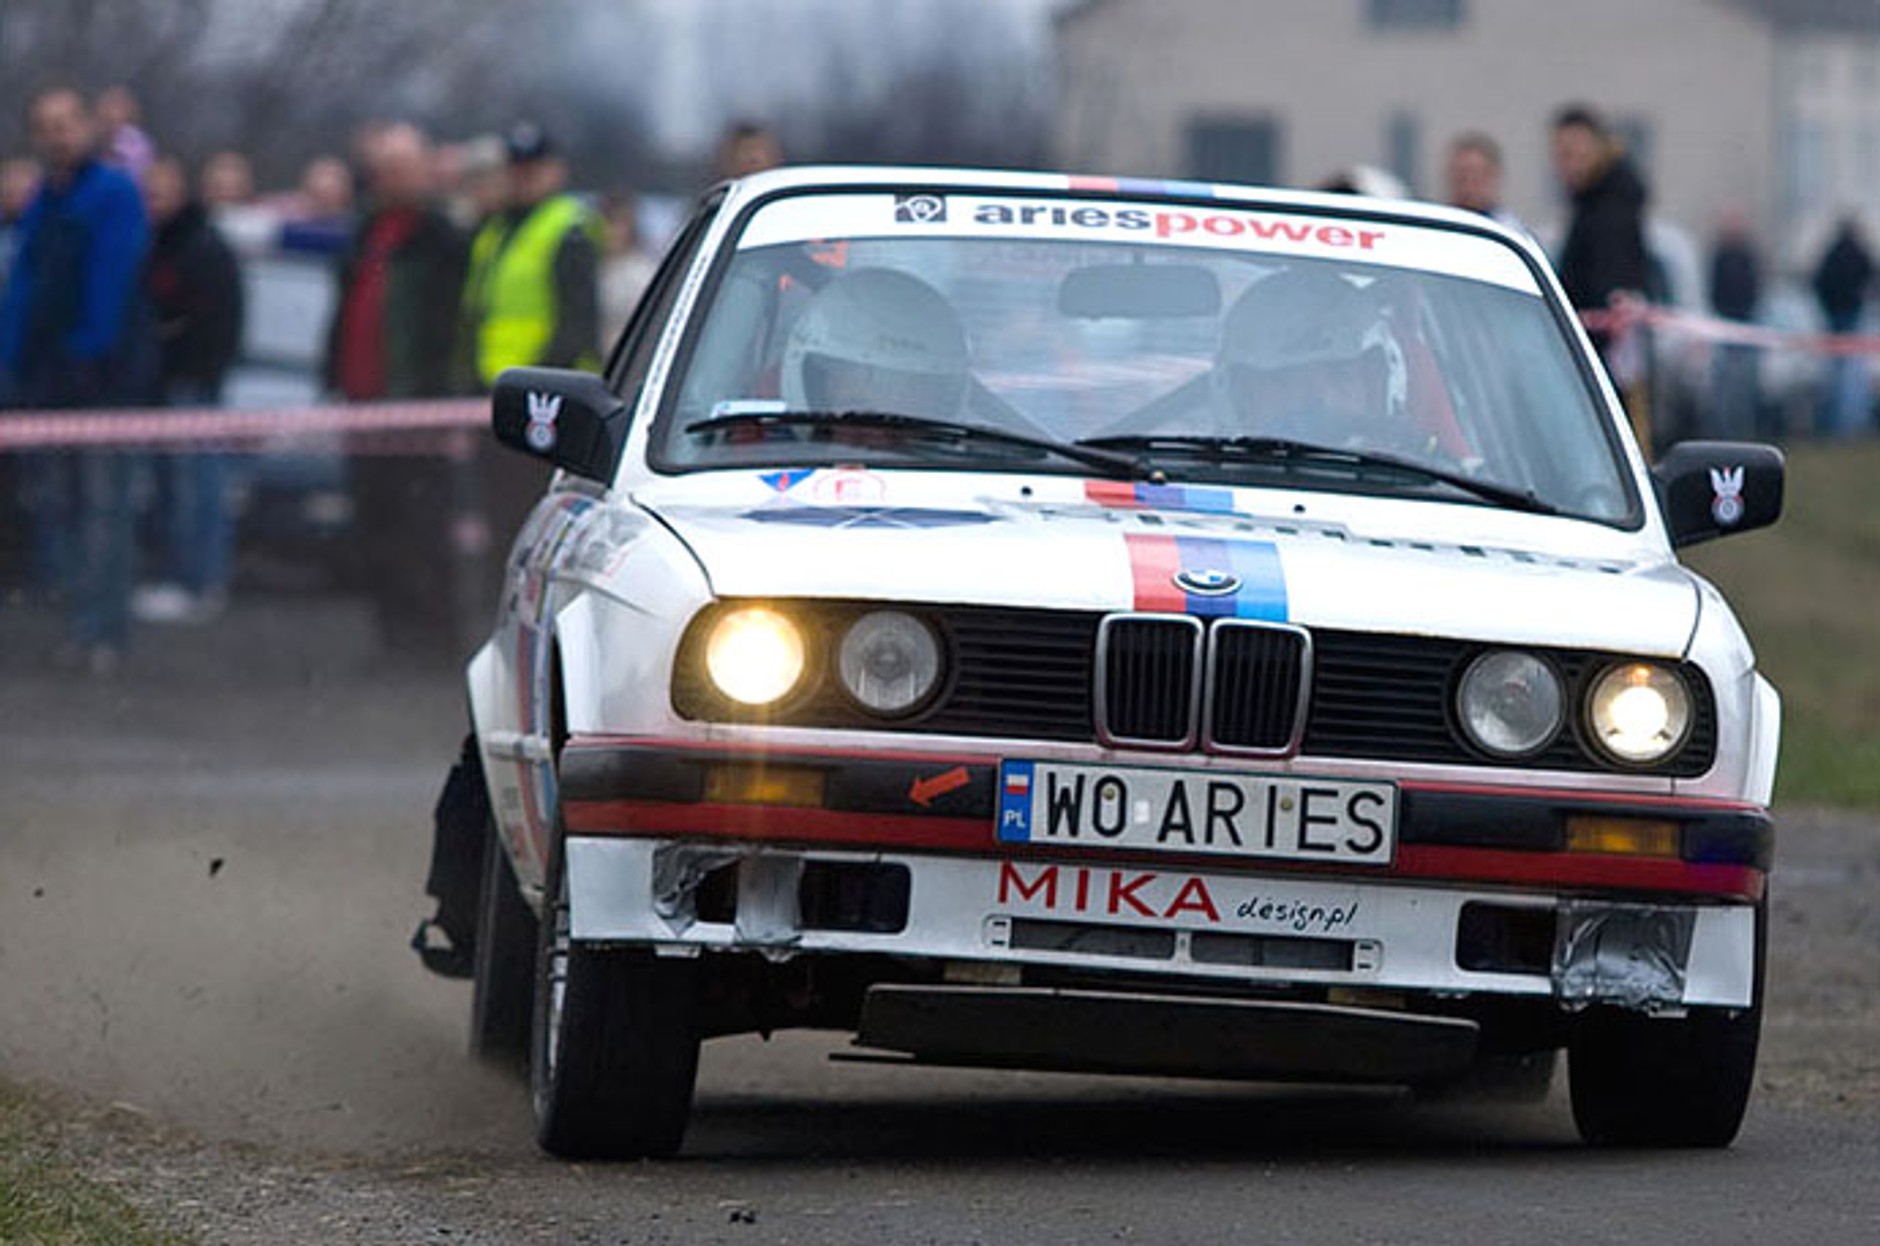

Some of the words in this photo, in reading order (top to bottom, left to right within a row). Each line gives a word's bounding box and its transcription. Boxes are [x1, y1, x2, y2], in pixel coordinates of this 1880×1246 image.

[974, 204, 1385, 250] ariespower
[1003, 810, 1026, 828] PL
[1157, 779, 1385, 855] ARIES
[998, 862, 1221, 923] MIKA
[1236, 897, 1358, 931] design.pl
